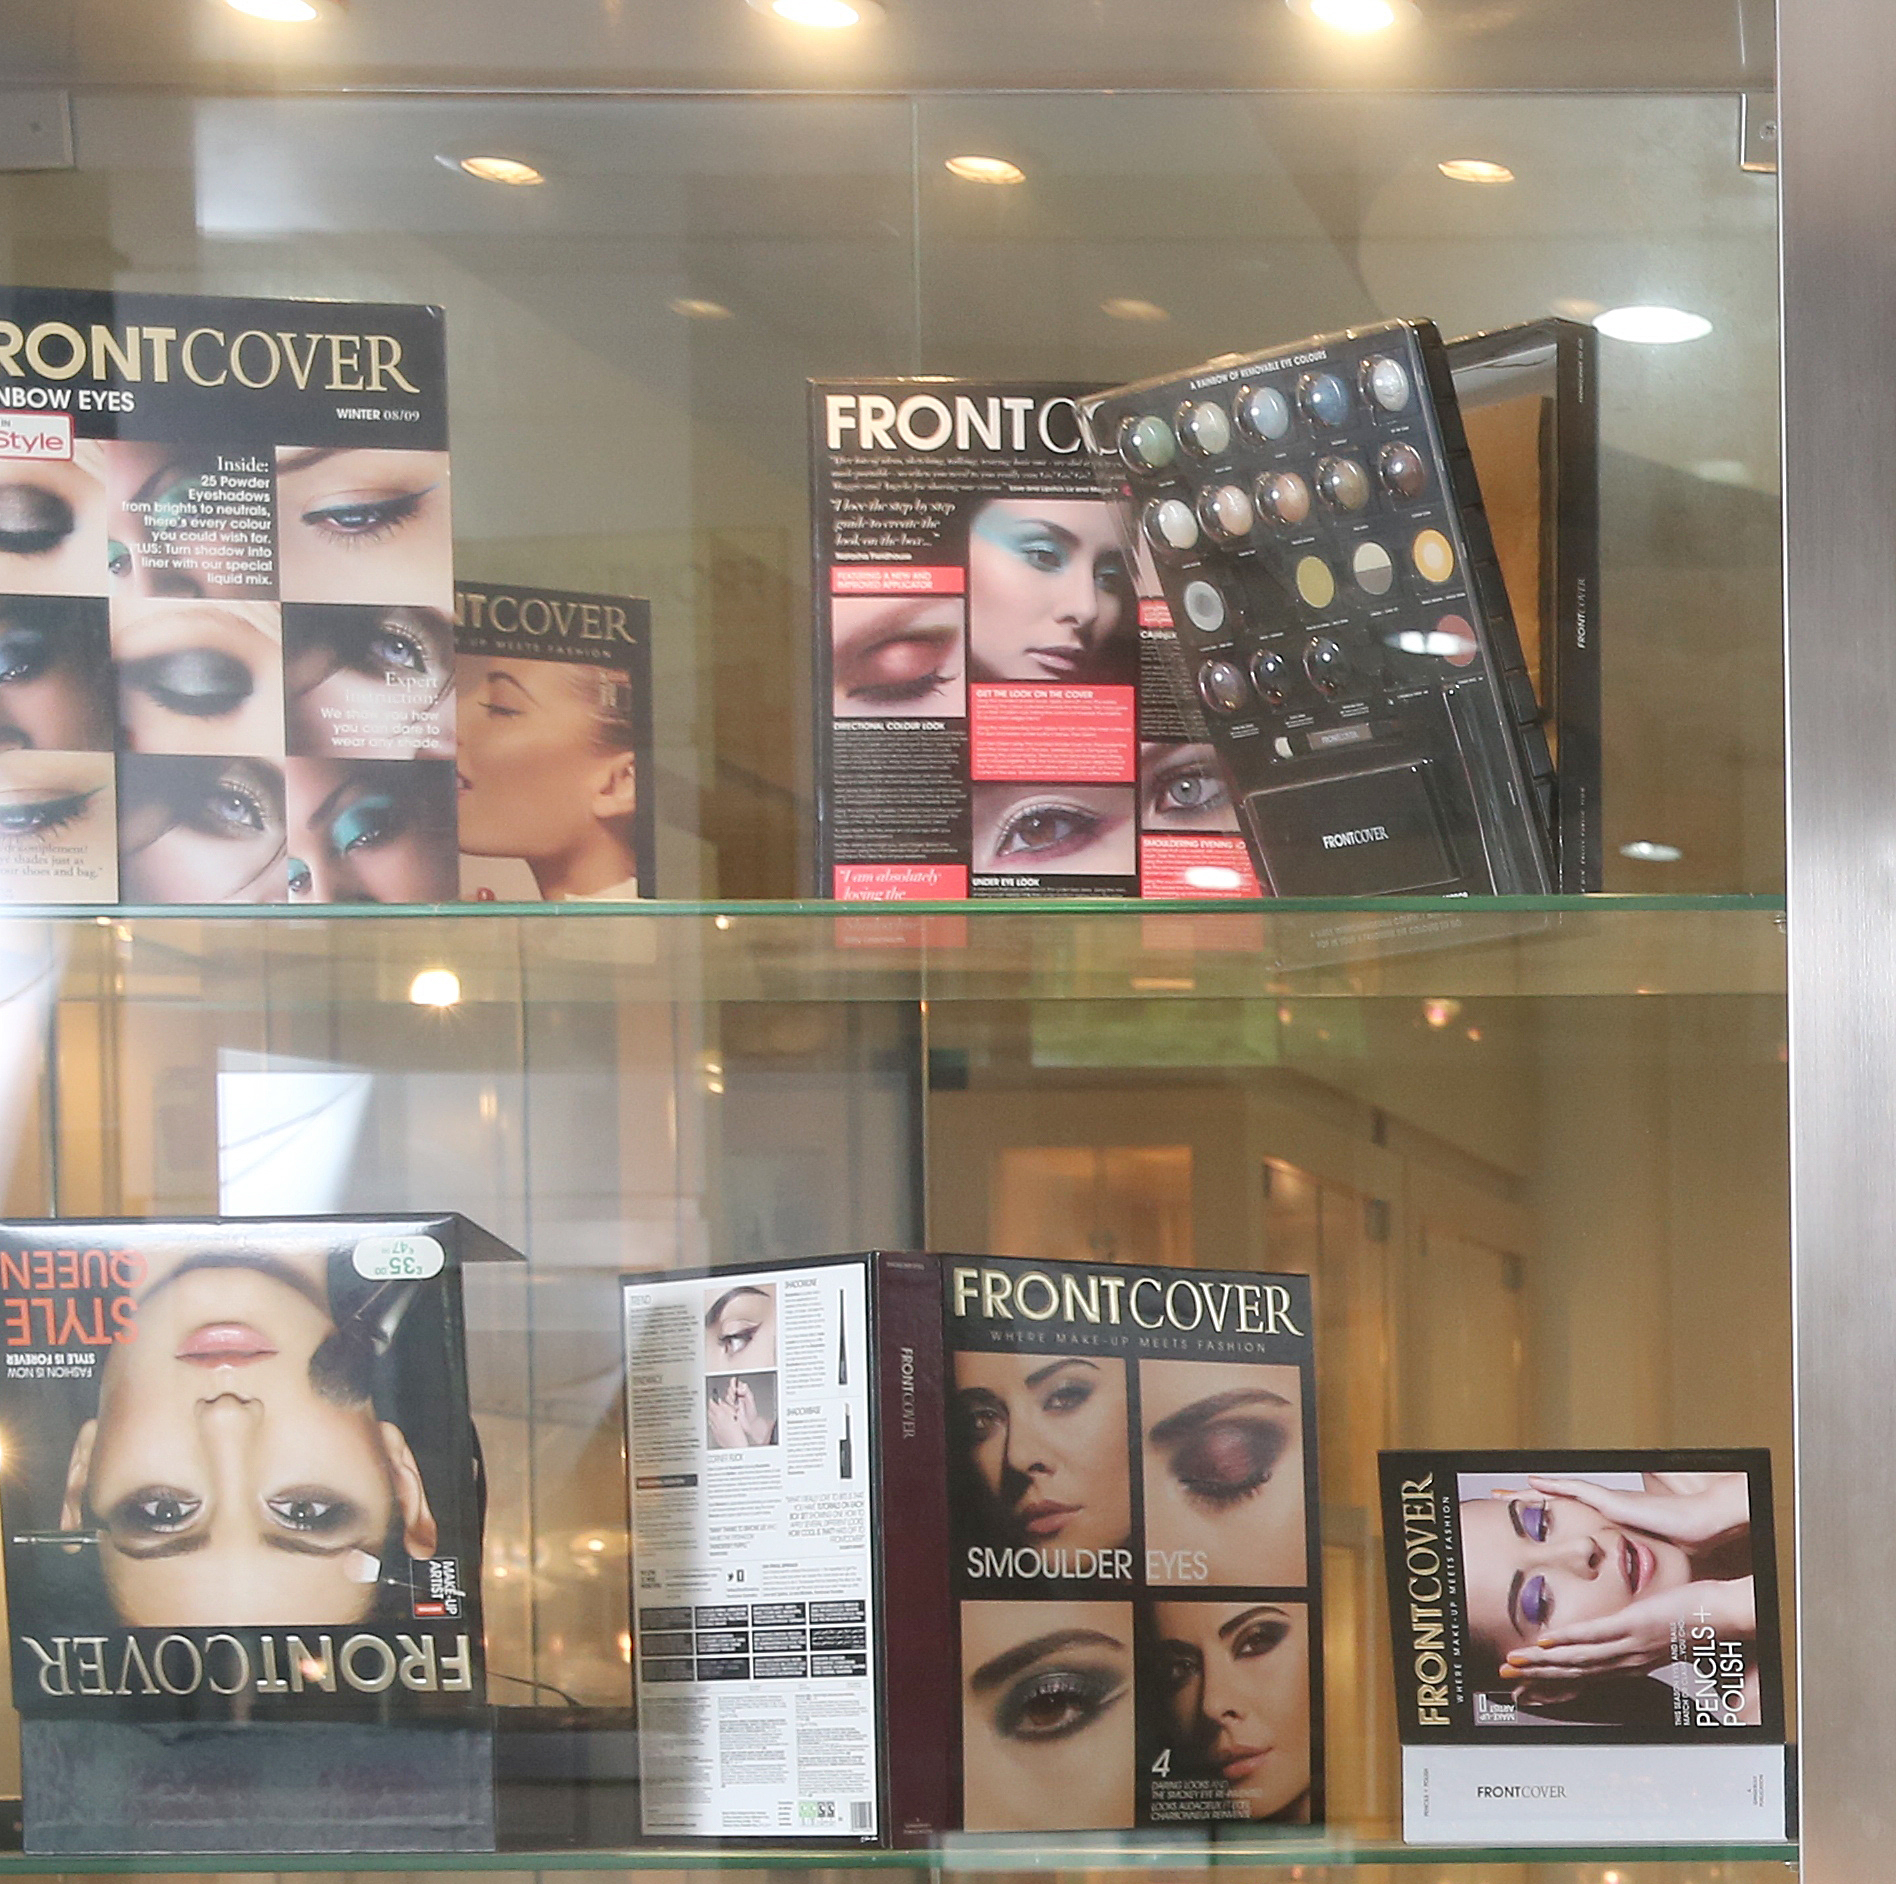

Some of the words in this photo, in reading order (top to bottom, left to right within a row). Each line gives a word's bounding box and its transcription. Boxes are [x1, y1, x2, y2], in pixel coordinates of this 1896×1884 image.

[1198, 374, 1226, 388] RAINBOW
[1229, 371, 1237, 381] OF
[1240, 362, 1277, 379] REMOVABLE
[1280, 358, 1292, 371] EYE
[1293, 351, 1327, 368] COLOURS
[337, 408, 380, 421] WINTER
[383, 410, 420, 423] 08/09
[217, 456, 269, 473] Inside:
[201, 476, 216, 488] 25
[220, 476, 270, 489] Powder
[189, 489, 270, 503] Eyeshadows
[122, 501, 151, 513] from
[154, 501, 197, 517] brights
[200, 503, 213, 515] to
[216, 503, 270, 518] neutrals,
[144, 516, 187, 529] there's
[190, 518, 227, 532] every
[230, 517, 271, 530] colour
[152, 531, 177, 544] you
[180, 529, 216, 542] could
[219, 530, 247, 543] wish
[251, 530, 271, 544] for.
[142, 558, 170, 569] liner
[172, 558, 198, 570] with
[201, 561, 223, 571] our
[226, 559, 272, 574] special
[208, 573, 242, 586] liquid
[246, 574, 272, 586] mix.
[1577, 578, 1586, 649] FRONTCOVER
[386, 672, 437, 689] Expert
[976, 689, 993, 699] GET
[995, 689, 1007, 699] THE
[1010, 689, 1033, 699] LOOK
[1036, 689, 1046, 699] ON
[1049, 690, 1062, 699] THE
[1064, 690, 1093, 699] COVER
[834, 722, 884, 731] DIRECTIONAL
[887, 722, 919, 731] COLOUR
[922, 722, 945, 731] LOOK
[1322, 826, 1388, 849] FRONTCOVER
[973, 878, 999, 887] UNDER
[1001, 878, 1014, 887] EYE
[1016, 878, 1039, 887] LOOK
[2, 1250, 147, 1290] QUEEN
[953, 1267, 1303, 1336] FRONTCOVER
[7, 1297, 139, 1345] STYLE
[989, 1330, 1045, 1343] WHERE
[1057, 1332, 1128, 1345] MAKE-UP
[1139, 1336, 1188, 1349] MEETS
[1197, 1340, 1266, 1353] FASHION
[6, 1354, 53, 1366] FOREVER
[56, 1354, 65, 1365] IS
[68, 1353, 96, 1365] STYLE
[8, 1366, 34, 1377] NOW
[37, 1366, 46, 1377] IS
[47, 1366, 92, 1378] FASHION
[901, 1347, 916, 1439] FRONTCOVER
[1443, 1496, 1453, 1552] FASHION
[967, 1547, 1133, 1580] SMOULDER
[1147, 1551, 1208, 1580] EYES
[429, 1561, 443, 1599] ARTIST
[1448, 1558, 1457, 1595] MEETS
[443, 1561, 457, 1615] MAKE-UP
[1403, 1472, 1450, 1726] FRONTCOVER
[1451, 1601, 1462, 1656] MAKE-UP
[22, 1634, 472, 1696] FRONTCOVER
[1455, 1656, 1463, 1704] WHERE
[1719, 1642, 1748, 1727] POLISH
[1152, 1749, 1171, 1777] 4
[1477, 1785, 1567, 1799] FRONTCOVER
